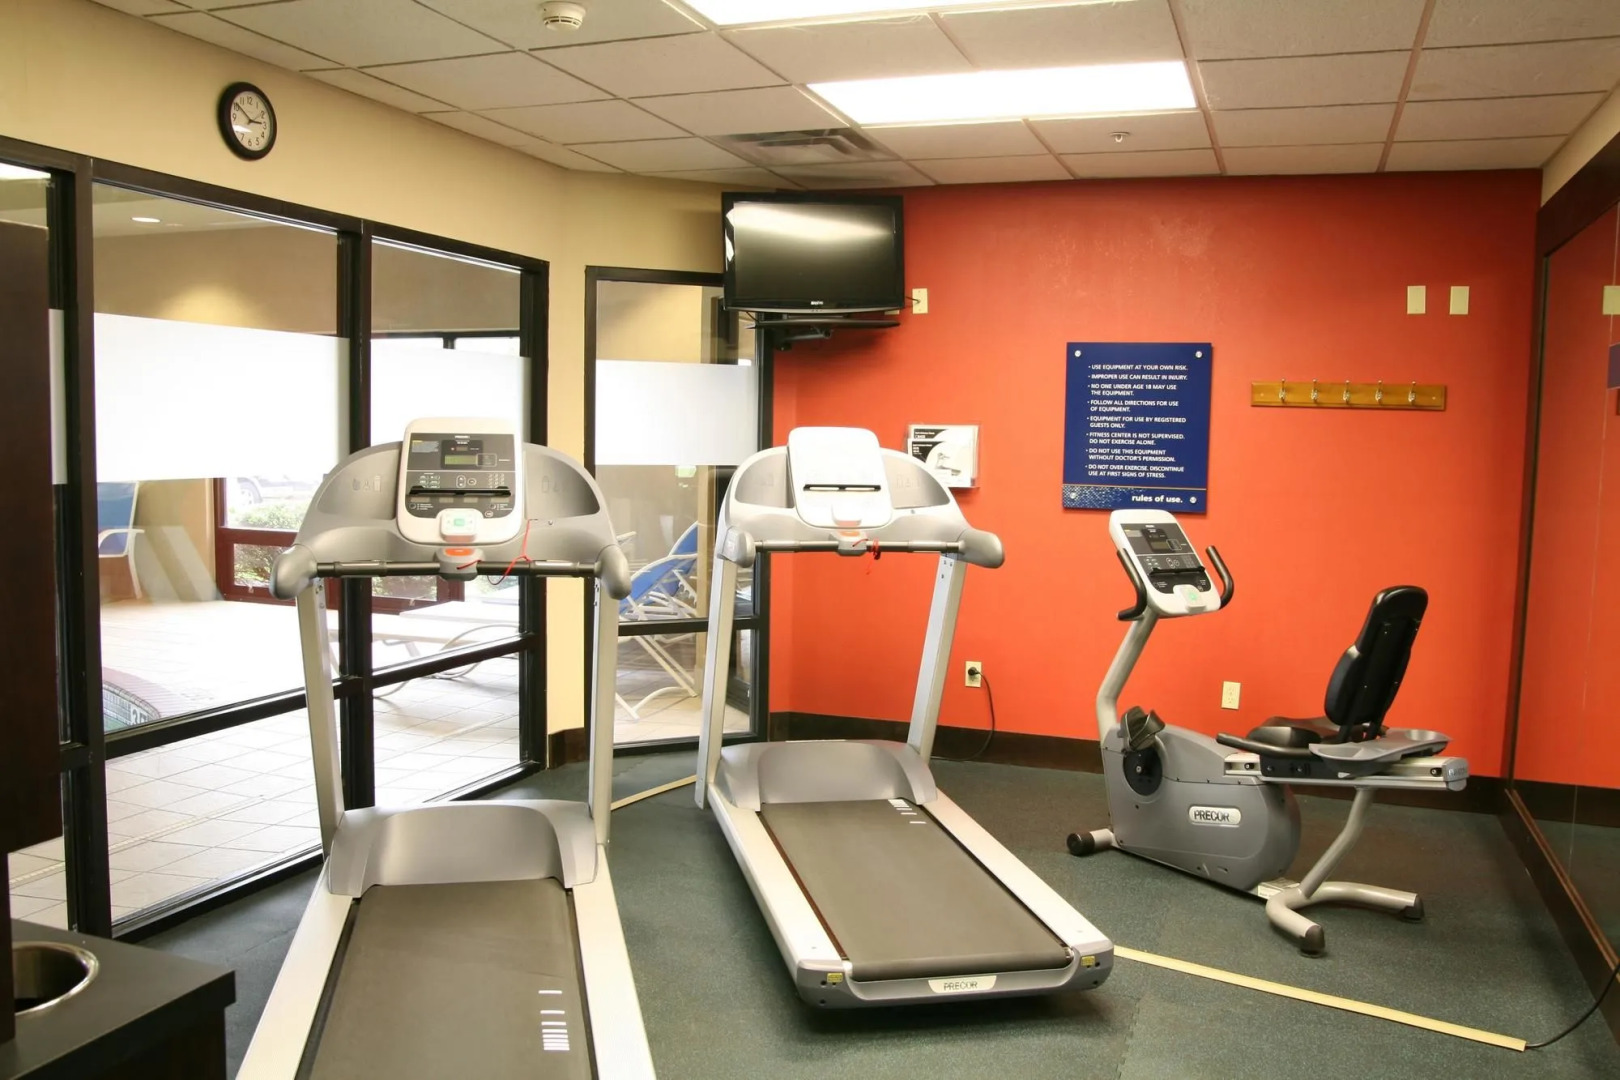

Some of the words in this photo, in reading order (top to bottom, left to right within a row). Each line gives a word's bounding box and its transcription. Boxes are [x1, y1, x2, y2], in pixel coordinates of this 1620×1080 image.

[240, 97, 244, 105] 11
[247, 96, 252, 105] 12
[234, 102, 239, 111] 10
[233, 113, 236, 121] 9
[261, 111, 265, 119] 2
[263, 122, 267, 130] 3
[256, 137, 259, 145] 5
[1194, 810, 1230, 822] PRECOR
[943, 981, 978, 991] PRECOR
